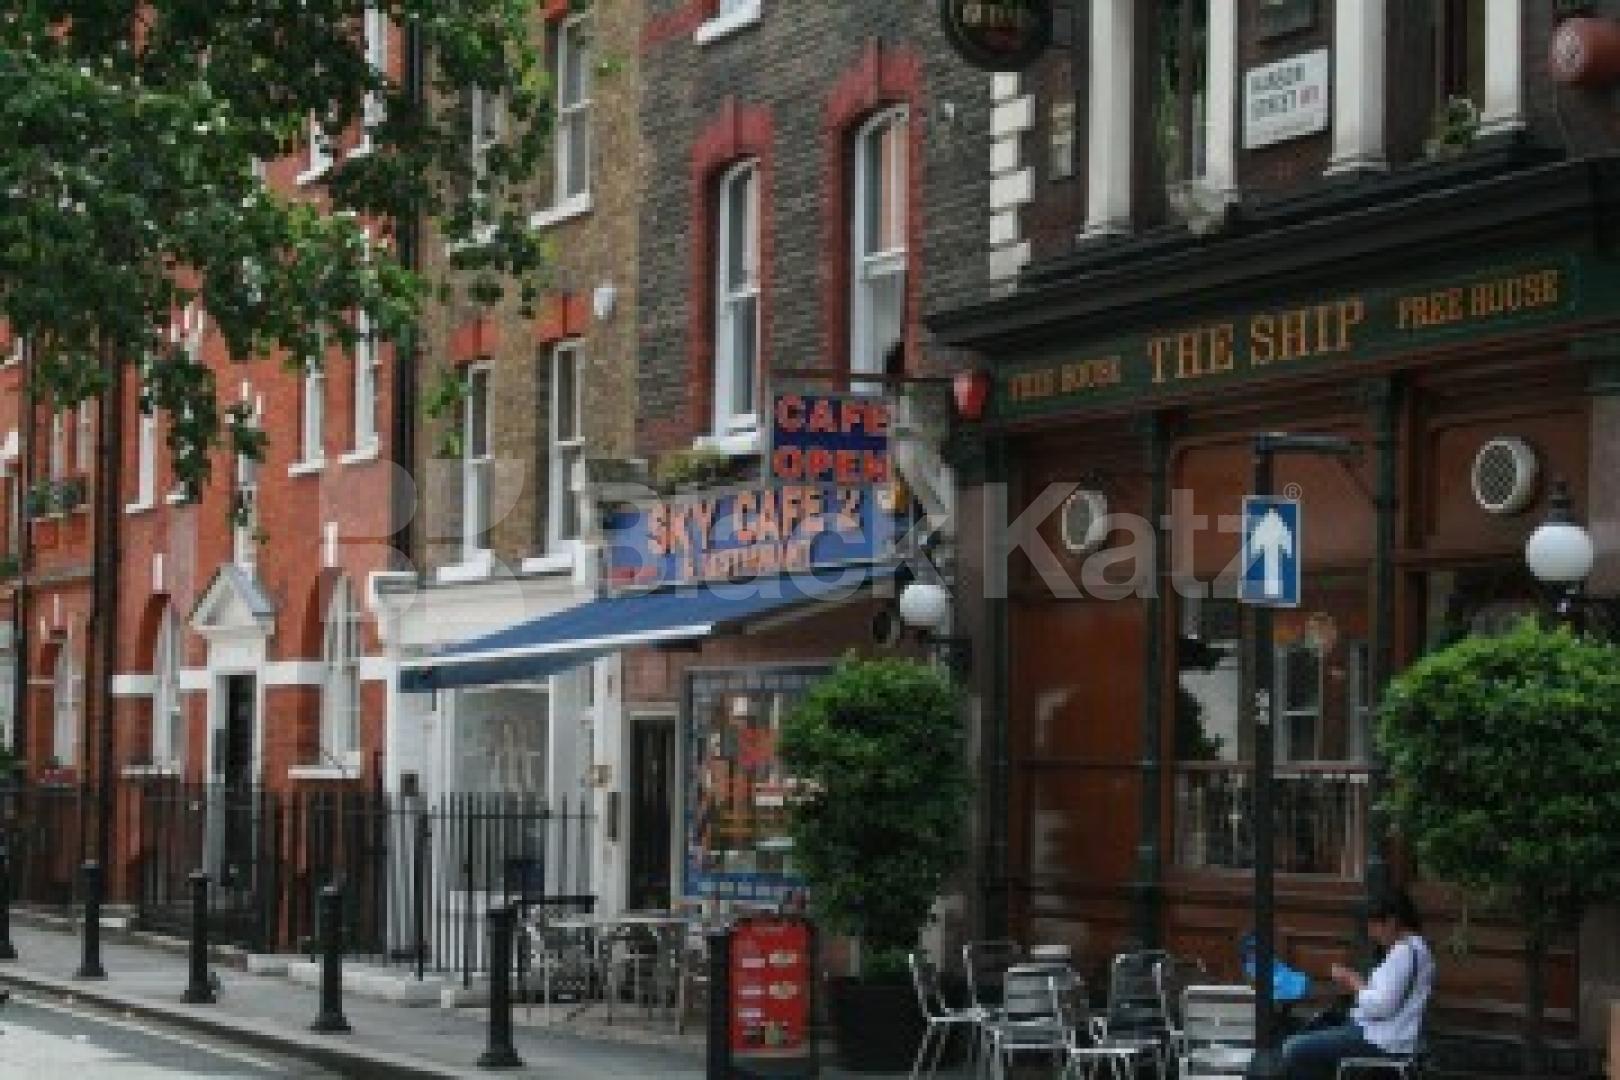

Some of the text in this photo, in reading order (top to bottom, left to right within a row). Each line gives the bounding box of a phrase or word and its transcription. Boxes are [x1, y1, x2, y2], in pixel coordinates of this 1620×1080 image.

[1396, 269, 1558, 330] FREE HOUSE
[1148, 297, 1364, 383] THE SHIP
[776, 393, 890, 434] CAFE
[773, 445, 889, 485] OPEN
[647, 494, 714, 557] SKY
[733, 485, 825, 543] CAFE
